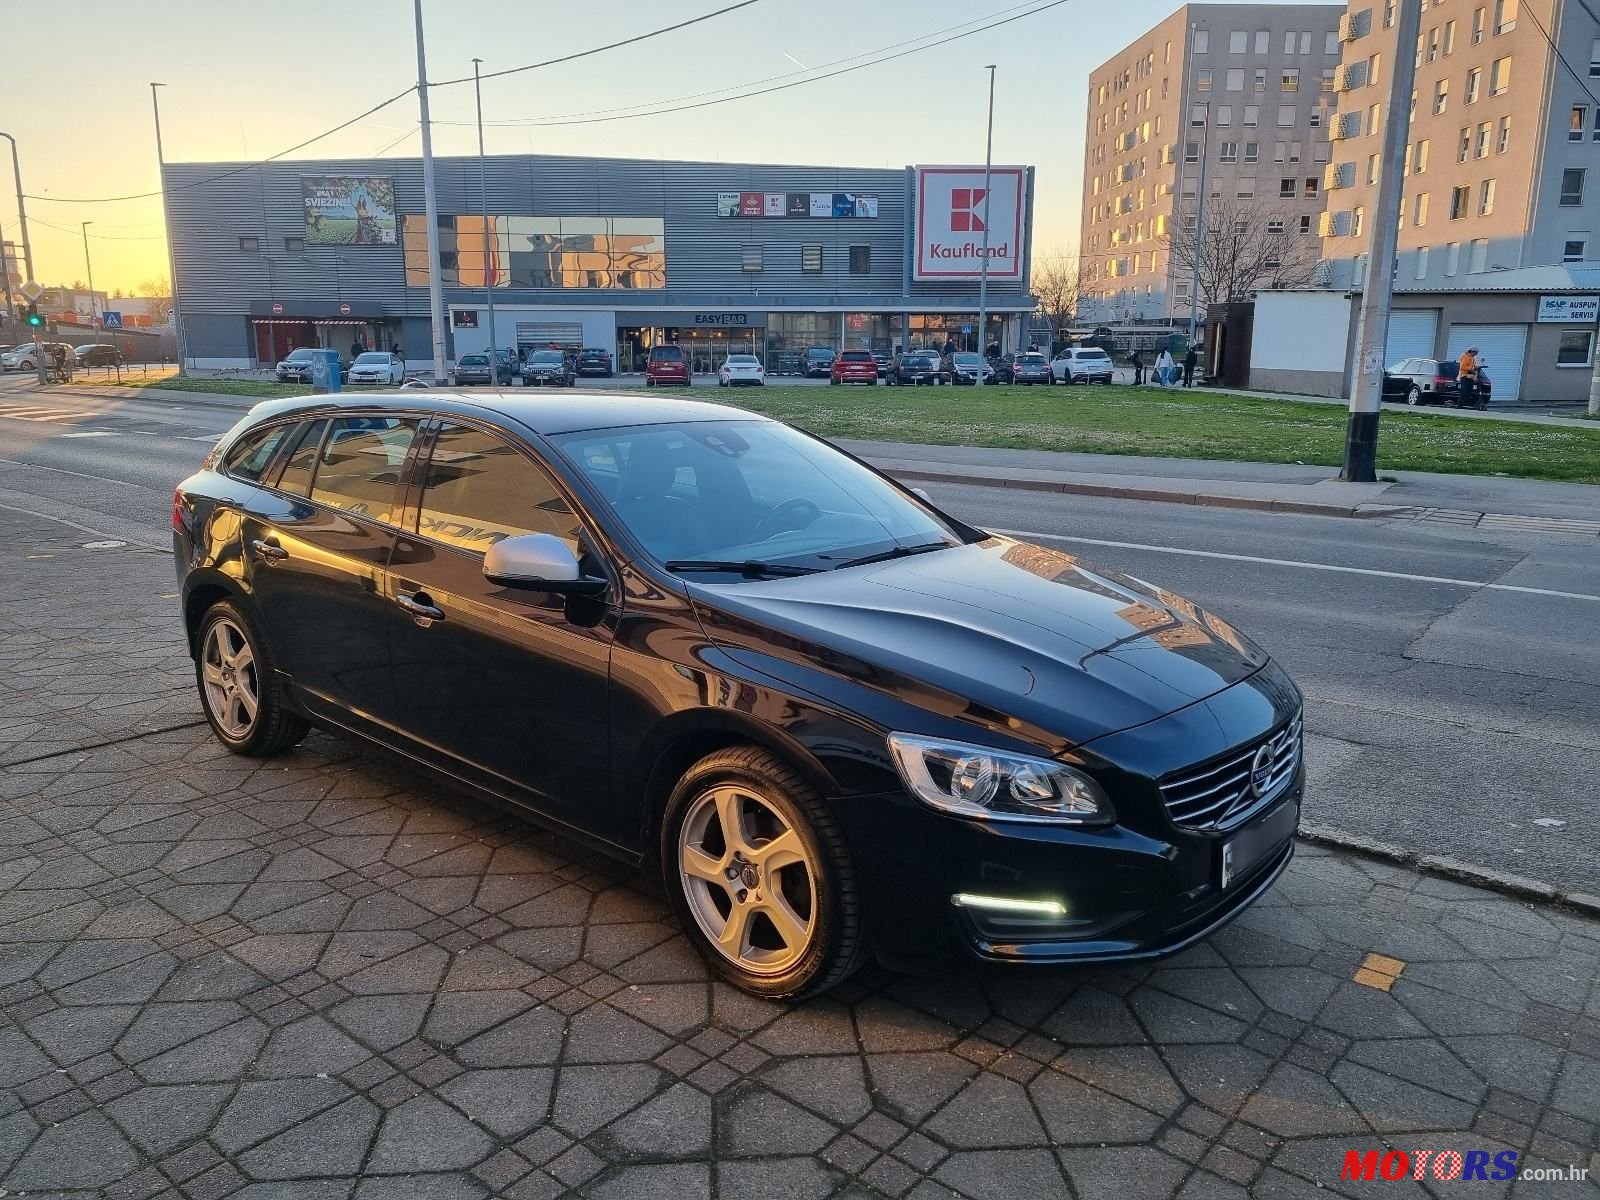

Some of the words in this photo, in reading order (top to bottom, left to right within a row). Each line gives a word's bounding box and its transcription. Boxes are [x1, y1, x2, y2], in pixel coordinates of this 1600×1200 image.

[930, 243, 1008, 259] Kaufland
[695, 314, 721, 324] EASY
[723, 314, 746, 324] BAR
